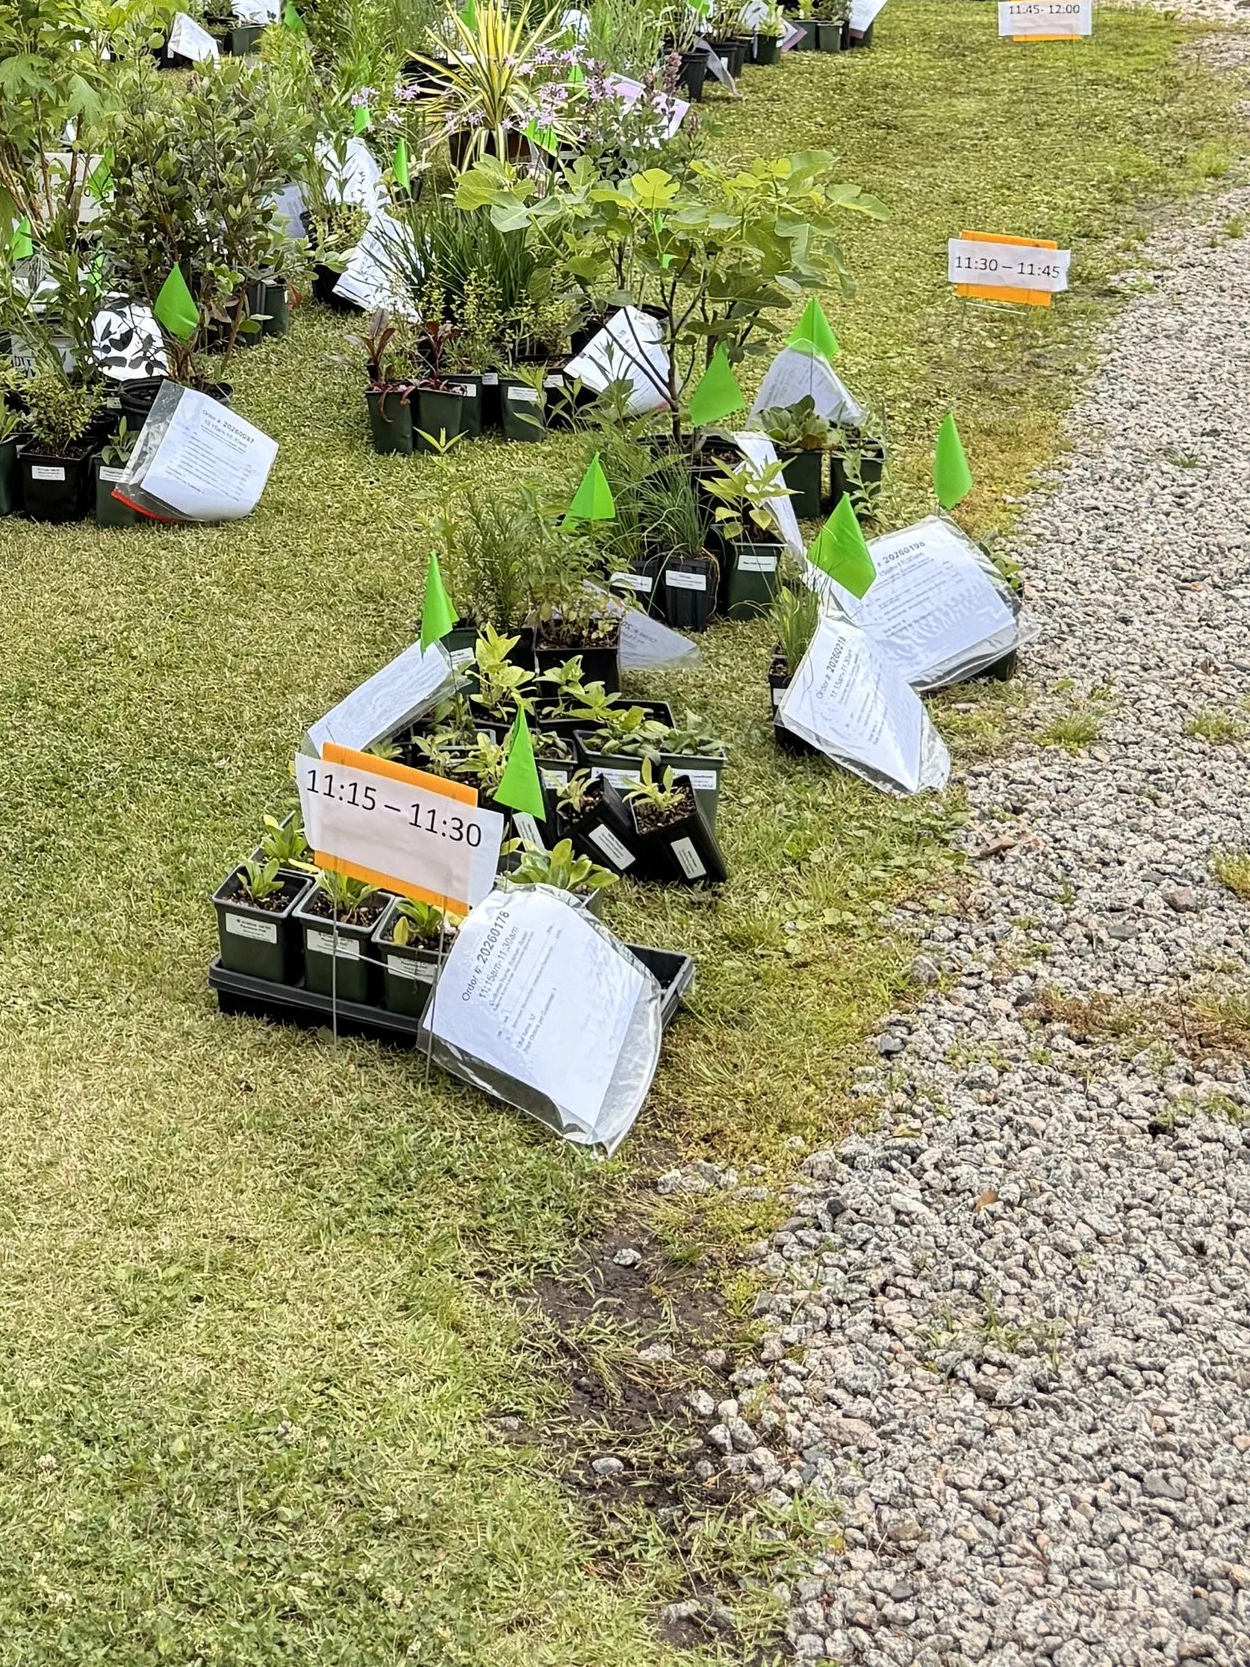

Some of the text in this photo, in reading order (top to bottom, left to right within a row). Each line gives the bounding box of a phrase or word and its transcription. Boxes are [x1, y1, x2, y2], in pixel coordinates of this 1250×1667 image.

[1049, 4, 1081, 15] 12:00
[955, 256, 998, 272] 11:30
[1017, 262, 1061, 279] 11:45
[306, 769, 377, 811] 11:15
[408, 803, 482, 848] 11:30
[478, 925, 520, 1000] 11:15am-11:30am
[461, 976, 479, 1002] Order
